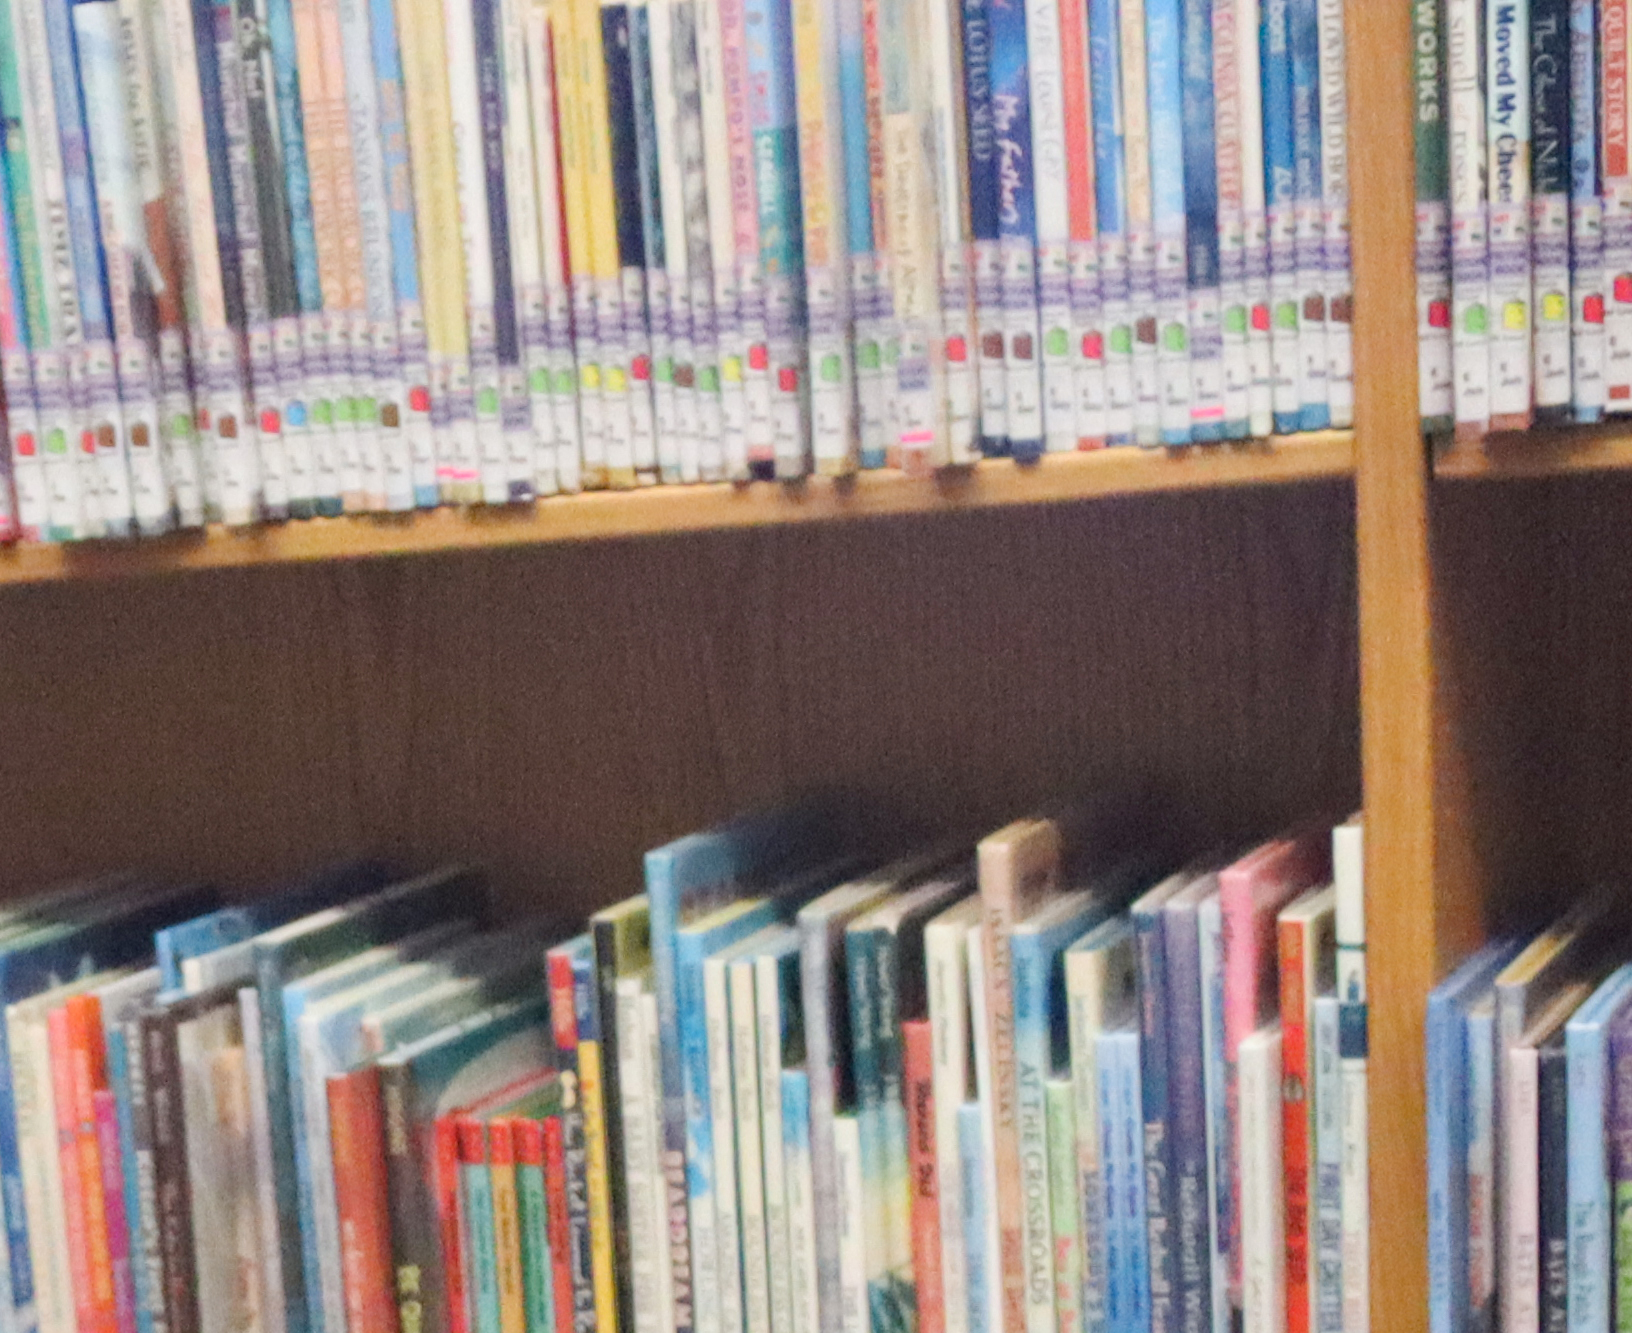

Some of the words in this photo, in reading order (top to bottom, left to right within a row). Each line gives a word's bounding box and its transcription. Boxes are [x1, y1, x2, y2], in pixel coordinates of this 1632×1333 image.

[966, 19, 991, 99] LOTUS
[1449, 17, 1477, 93] smell
[1494, 5, 1518, 87] Moved
[1532, 14, 1559, 51] The
[1603, 5, 1626, 75] QUILT
[970, 104, 994, 162] SEED
[993, 94, 1020, 131] My
[1489, 93, 1518, 127] My
[1605, 76, 1627, 148] STORY
[1451, 131, 1469, 206] roses
[1020, 1062, 1040, 1091] AT
[564, 1112, 584, 1147] How
[1022, 1101, 1044, 1142] THE
[1145, 1121, 1166, 1155] The
[565, 1149, 588, 1212] Rocket
[1145, 1159, 1167, 1213] Great
[666, 1150, 693, 1328] BEARDREAM
[1024, 1150, 1049, 1305] CROSSROADS
[1180, 1175, 1202, 1282] Redwall
[1575, 1201, 1596, 1228] The
[397, 1263, 421, 1293] BE
[569, 1216, 589, 1285] Learned
[1547, 1239, 1567, 1297] BATS
[1549, 1306, 1567, 1332] AT
